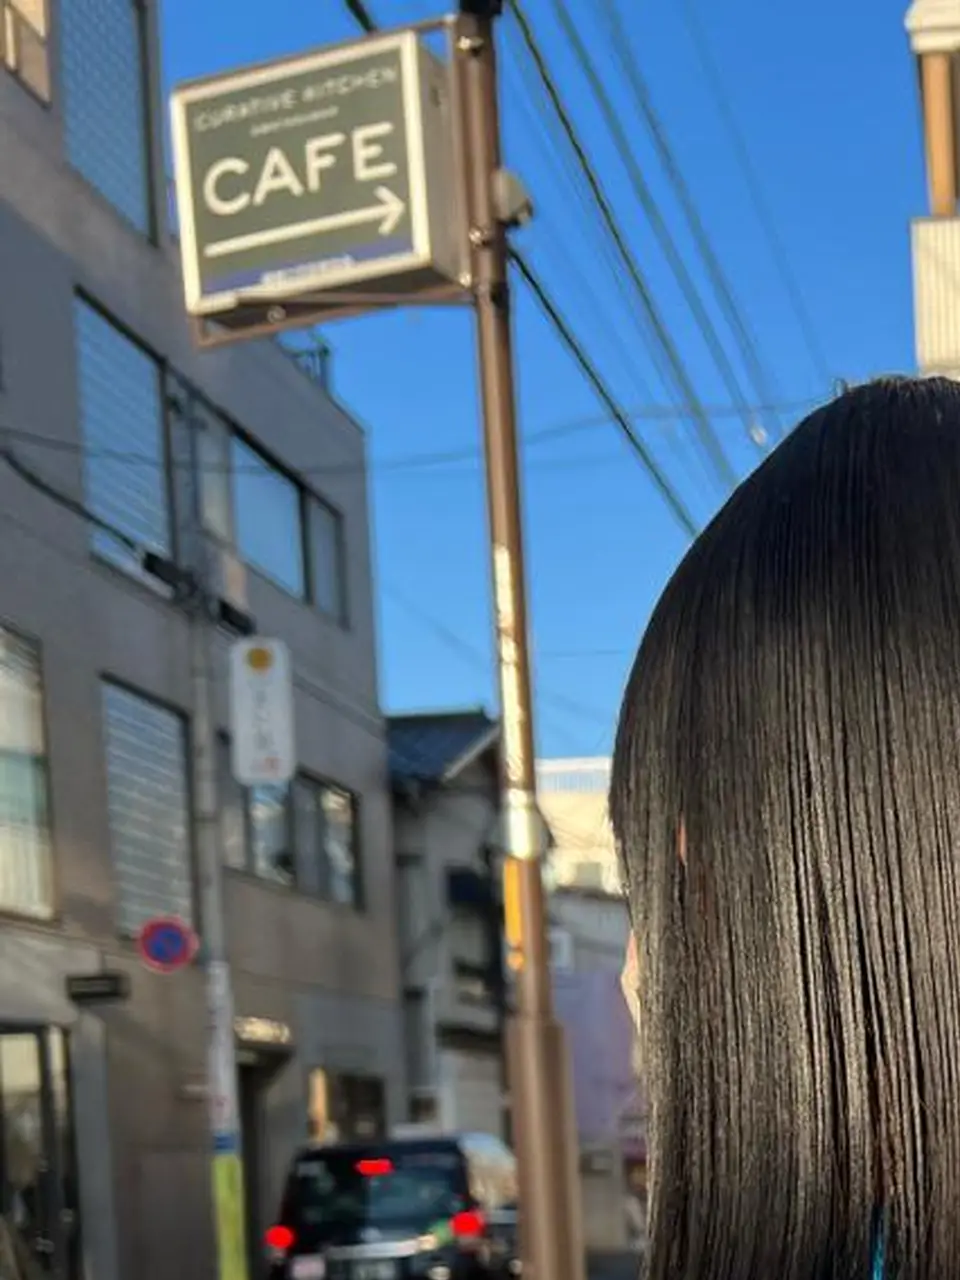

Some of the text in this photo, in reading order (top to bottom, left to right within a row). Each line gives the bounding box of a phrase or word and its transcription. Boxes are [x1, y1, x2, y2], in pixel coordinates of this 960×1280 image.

[195, 90, 297, 131] CURATIVE
[303, 69, 395, 101] KITCHEN
[204, 122, 396, 215] CAFE
